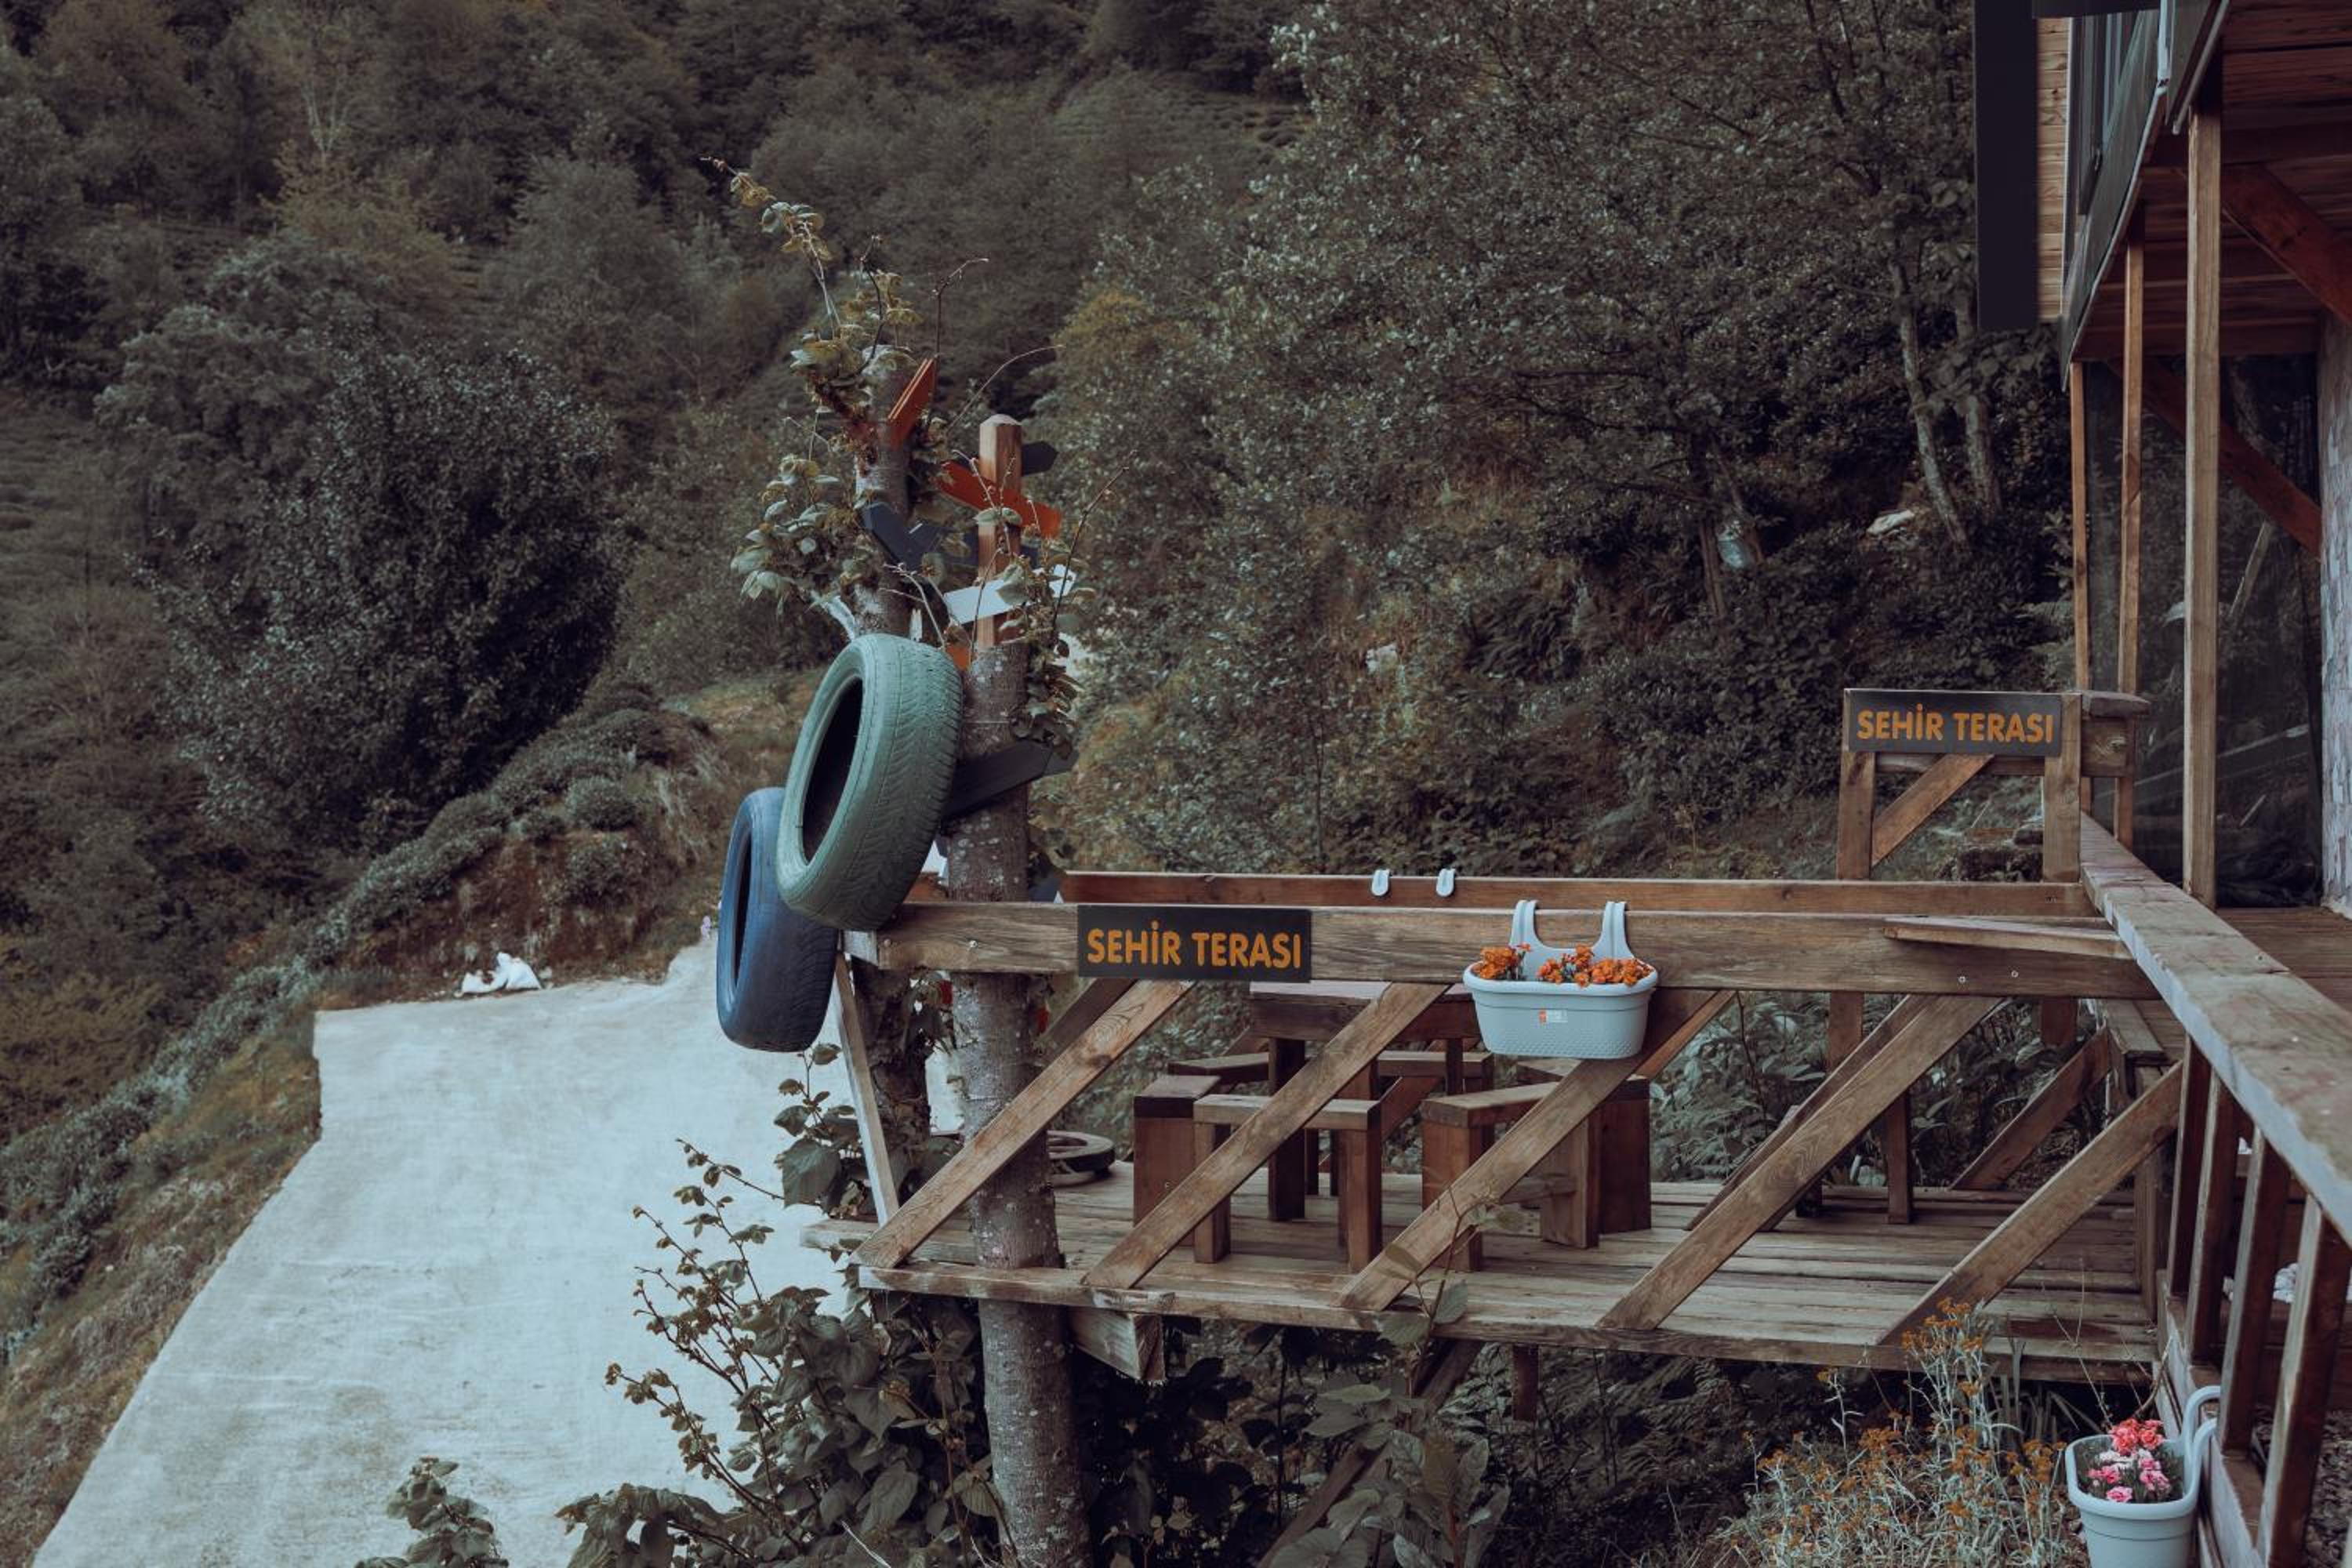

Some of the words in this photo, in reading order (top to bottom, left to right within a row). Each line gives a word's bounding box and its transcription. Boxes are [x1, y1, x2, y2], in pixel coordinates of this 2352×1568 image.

[1857, 703, 1944, 741] SEHİR
[1953, 711, 2054, 743] TERASI
[1087, 920, 1181, 966] SEHİR
[1191, 931, 1301, 969] TERASI
